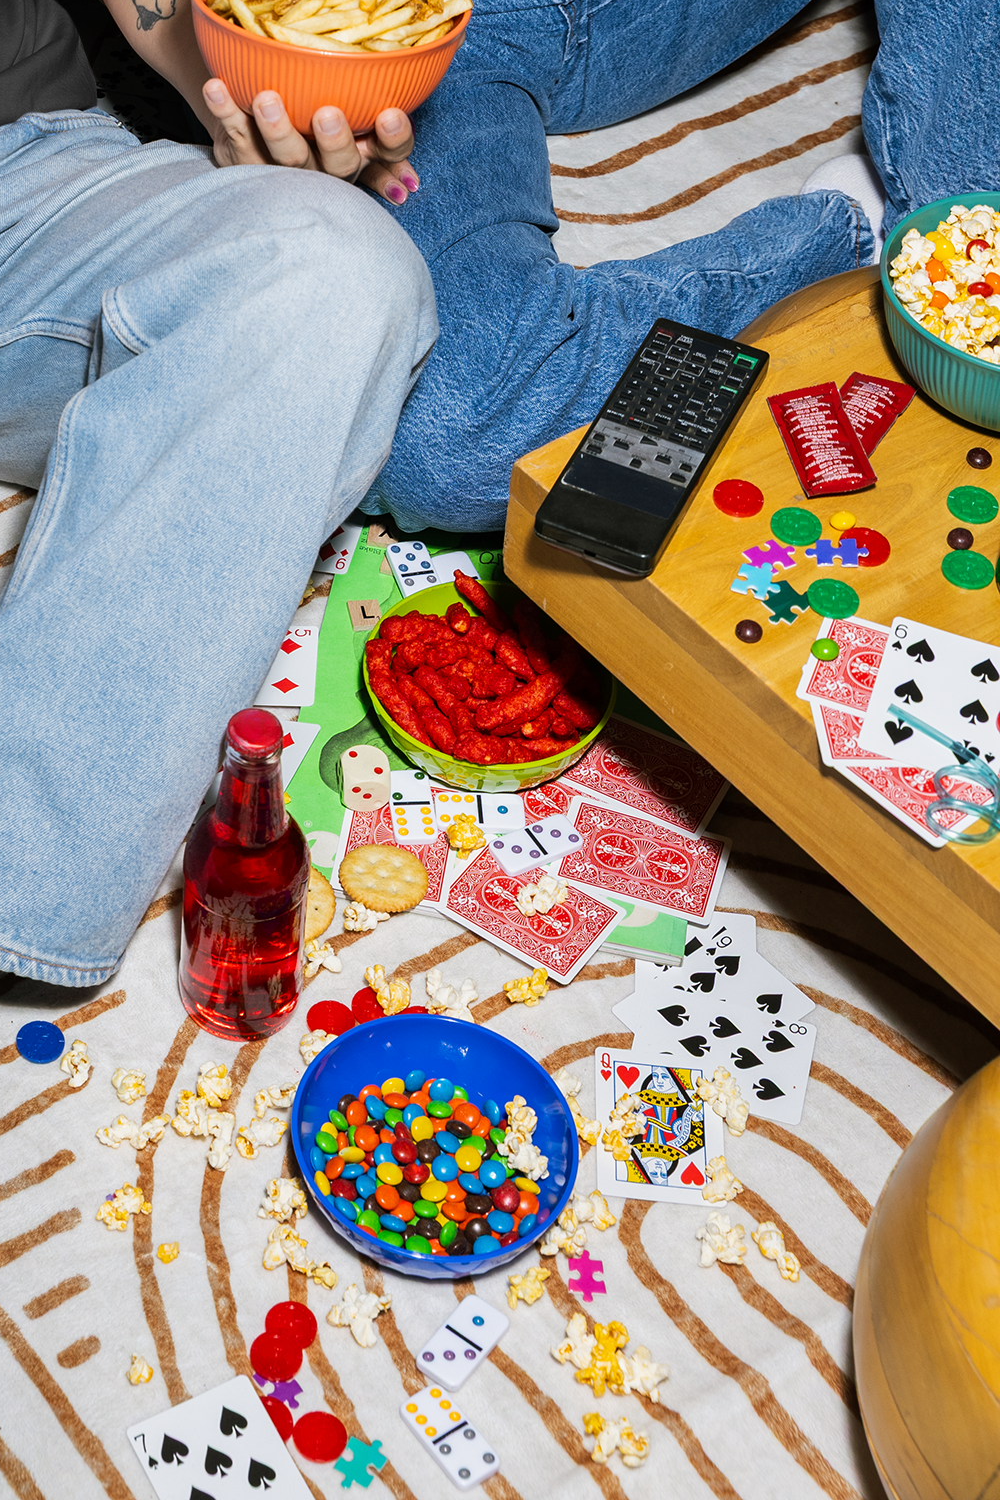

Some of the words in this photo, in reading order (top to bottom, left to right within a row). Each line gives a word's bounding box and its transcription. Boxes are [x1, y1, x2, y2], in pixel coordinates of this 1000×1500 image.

[360, 606, 375, 619] L
[295, 629, 311, 637] 5
[894, 624, 908, 639] 6
[789, 1023, 808, 1036] 8
[600, 1052, 611, 1069] Q
[134, 1433, 148, 1454] 7
